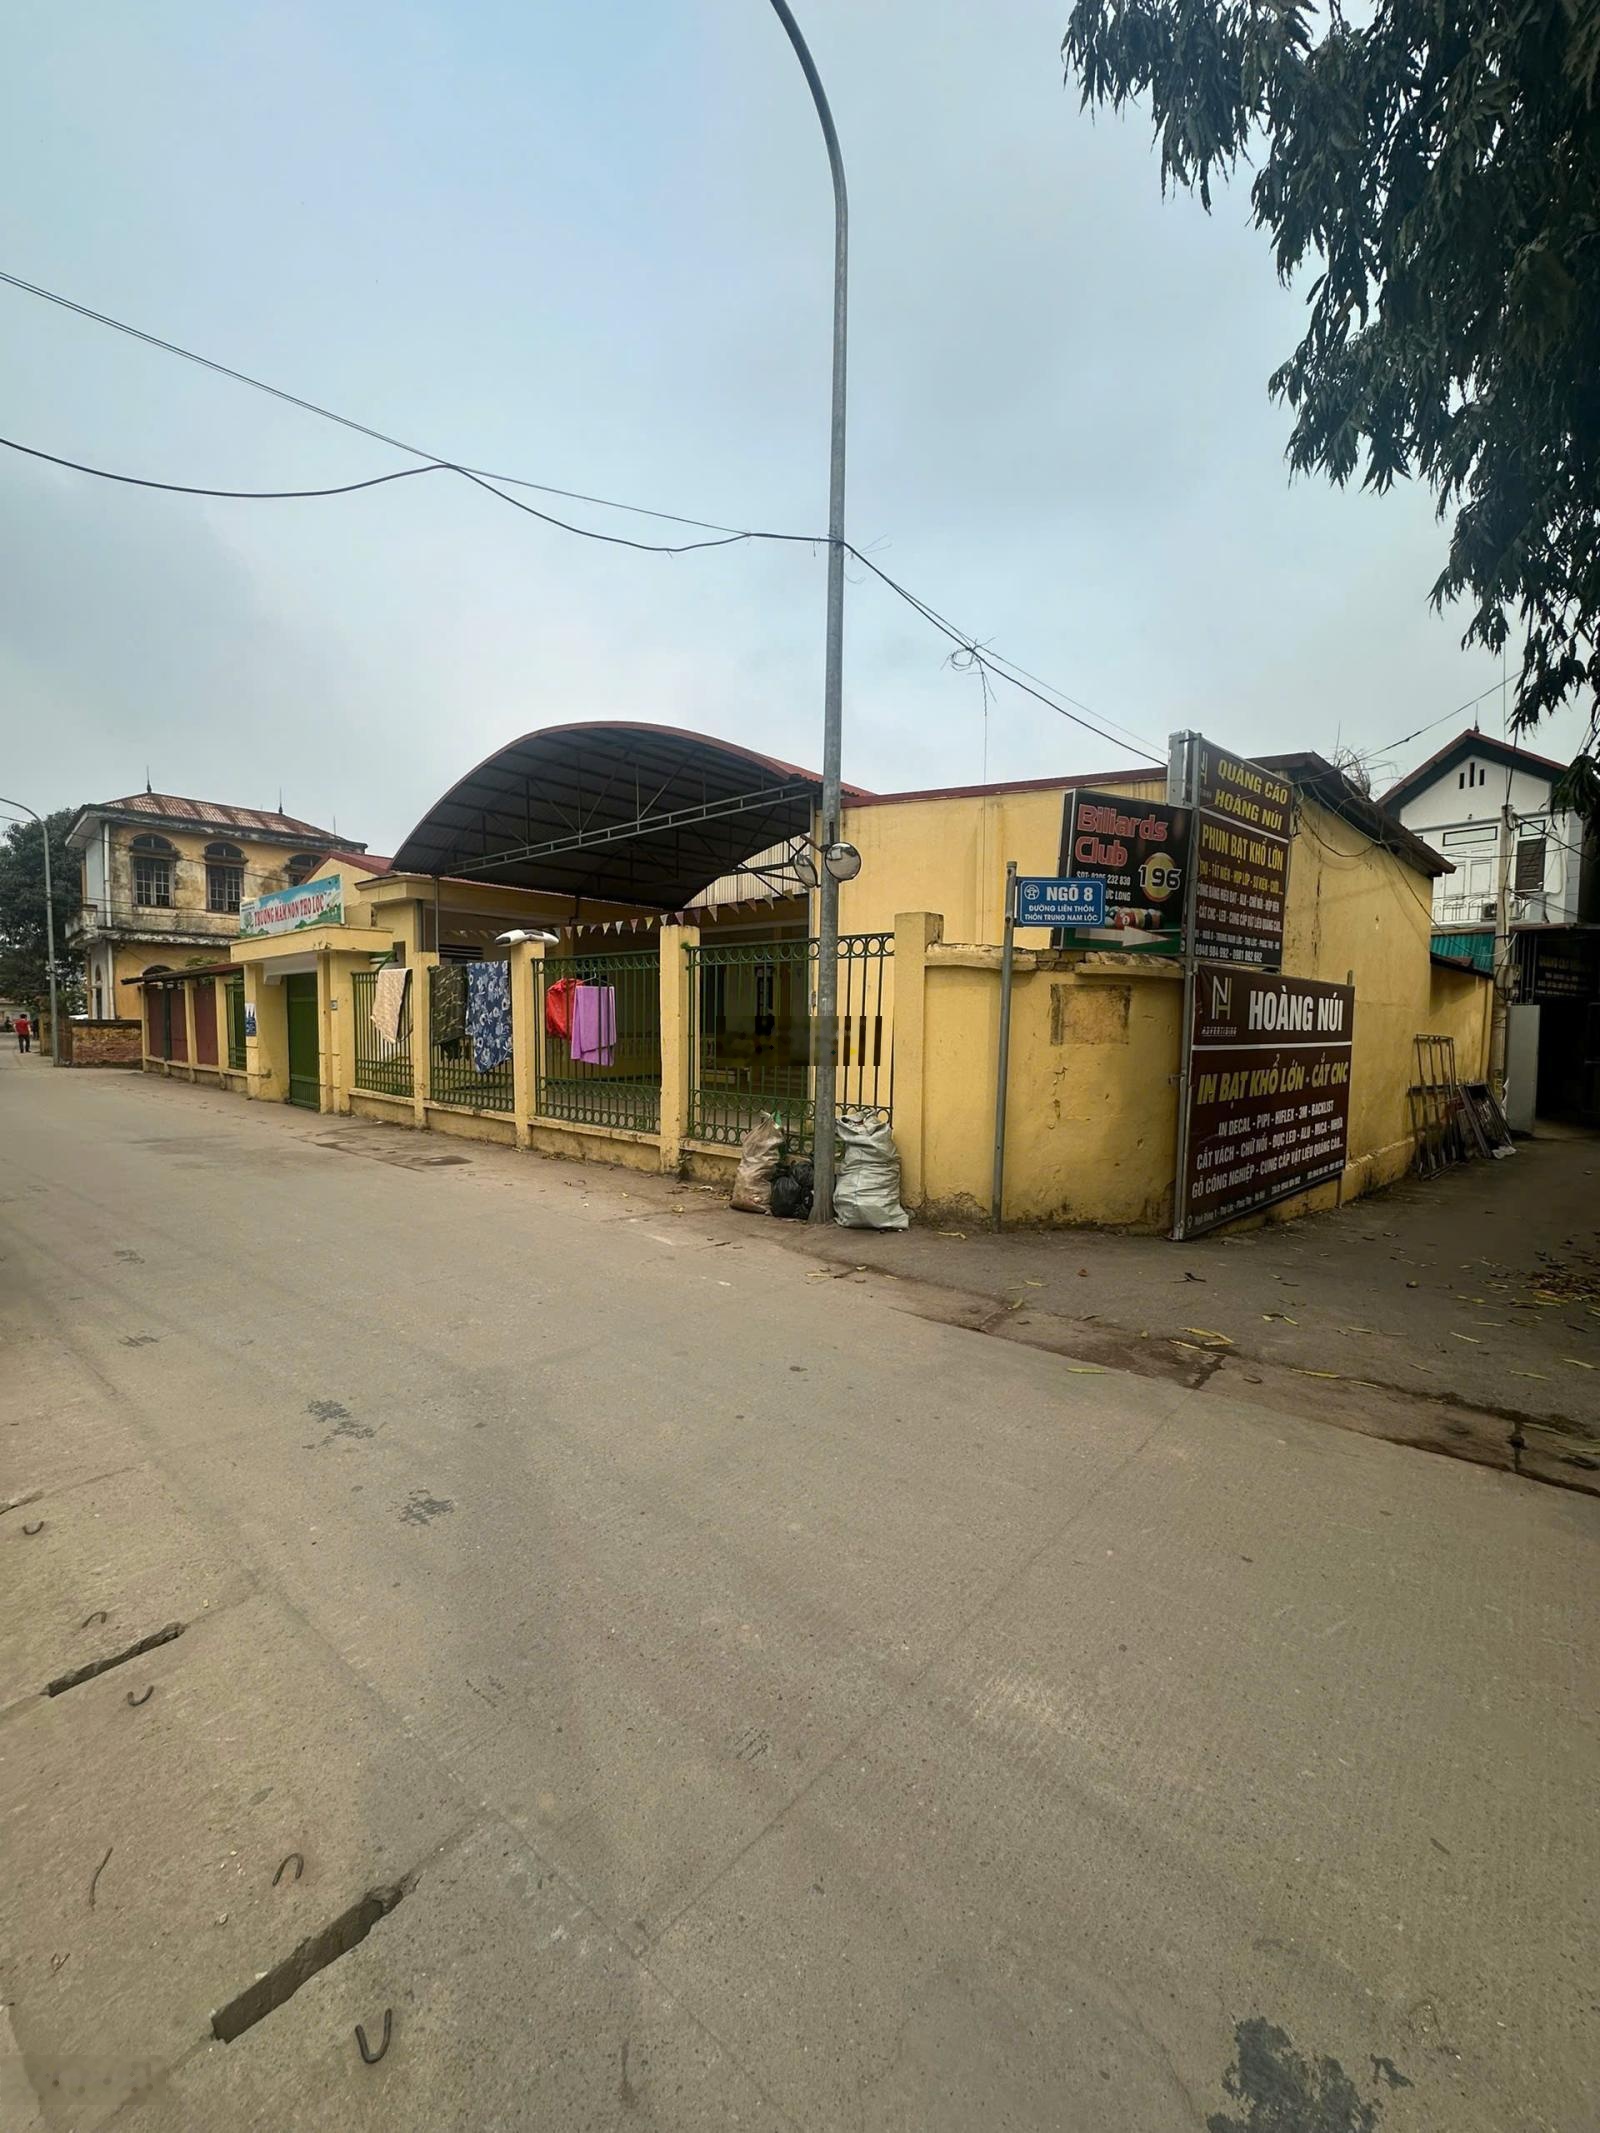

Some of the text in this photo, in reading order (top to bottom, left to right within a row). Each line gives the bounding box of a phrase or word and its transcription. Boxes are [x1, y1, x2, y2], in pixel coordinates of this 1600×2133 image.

[1218, 760, 1288, 805] QUẢNG CÁO
[1077, 803, 1168, 842] Billiards
[1215, 789, 1283, 831] HOÀNG NÚI
[1075, 835, 1128, 867] Club
[1202, 824, 1284, 871] PHUN BẠT KHỔ LỚN
[1046, 884, 1093, 902] NGÕ 8
[1107, 874, 1119, 885] 232
[1138, 864, 1182, 890] 196
[287, 901, 299, 920] NON
[1028, 903, 1094, 912] ĐƯỜNG LIÊN THÔN
[1115, 890, 1131, 901] LONG
[1024, 913, 1043, 921] THÔN
[1084, 913, 1098, 922] LỘC
[1248, 985, 1314, 1031] HOÀNG
[1317, 992, 1344, 1031] NÚI
[1197, 1052, 1349, 1109] IN BẠT KHỔ LỚN CẮT CNC
[1218, 1122, 1228, 1137] IN
[1228, 1117, 1251, 1136] DECAL
[1256, 1113, 1270, 1129] PIPI
[1197, 1146, 1213, 1169] CẮT
[1214, 1144, 1235, 1166] VÁCH
[1240, 1137, 1256, 1158] CHỮ
[1285, 1130, 1297, 1145] LED
[1205, 1175, 1228, 1194] CÔNG
[1228, 1163, 1255, 1184] NGHIỆP
[1260, 1157, 1278, 1175] CUNG
[1278, 1149, 1290, 1169] CẤP
